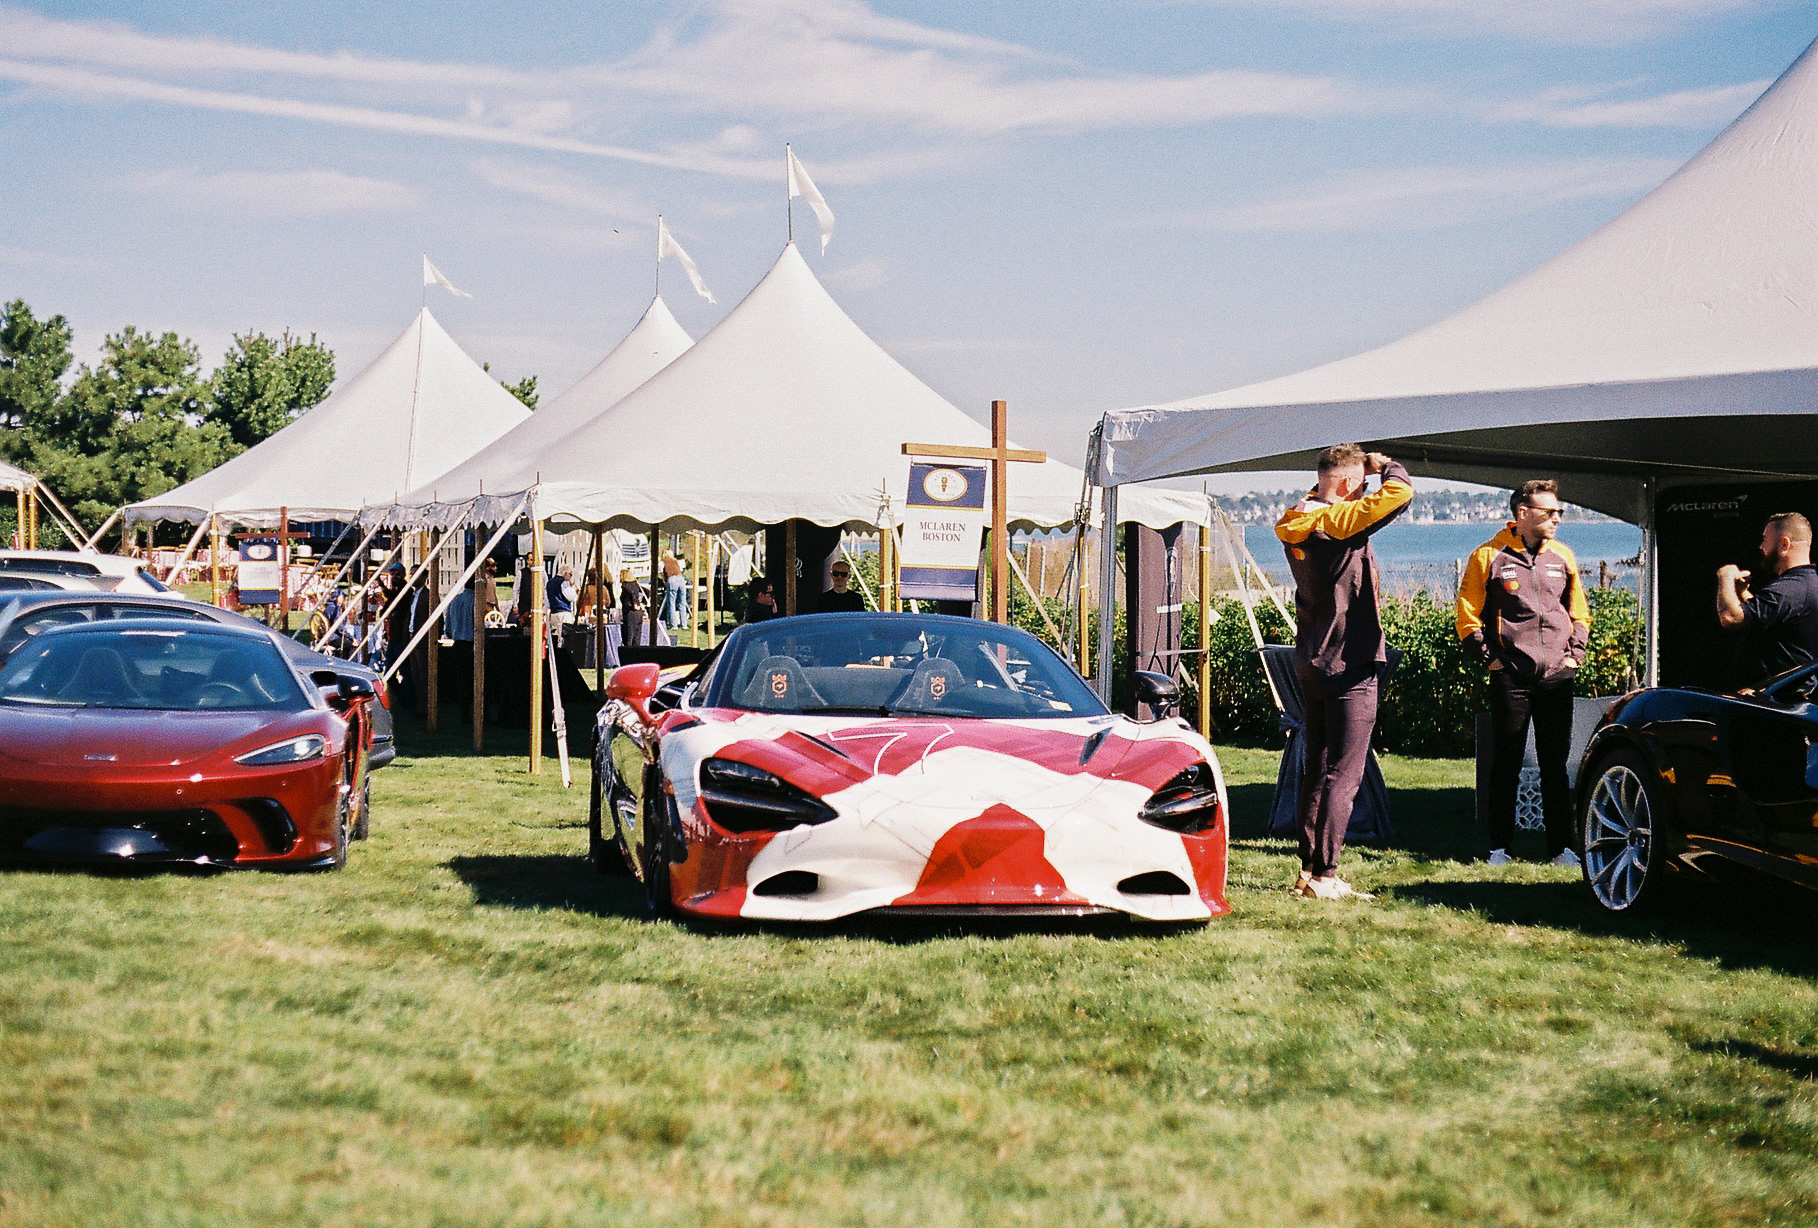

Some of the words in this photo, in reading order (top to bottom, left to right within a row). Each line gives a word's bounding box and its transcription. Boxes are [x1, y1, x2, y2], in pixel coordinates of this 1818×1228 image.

[1666, 501, 1739, 512] McLaren
[919, 521, 966, 531] MCLAREN
[922, 532, 961, 542] BOSTON
